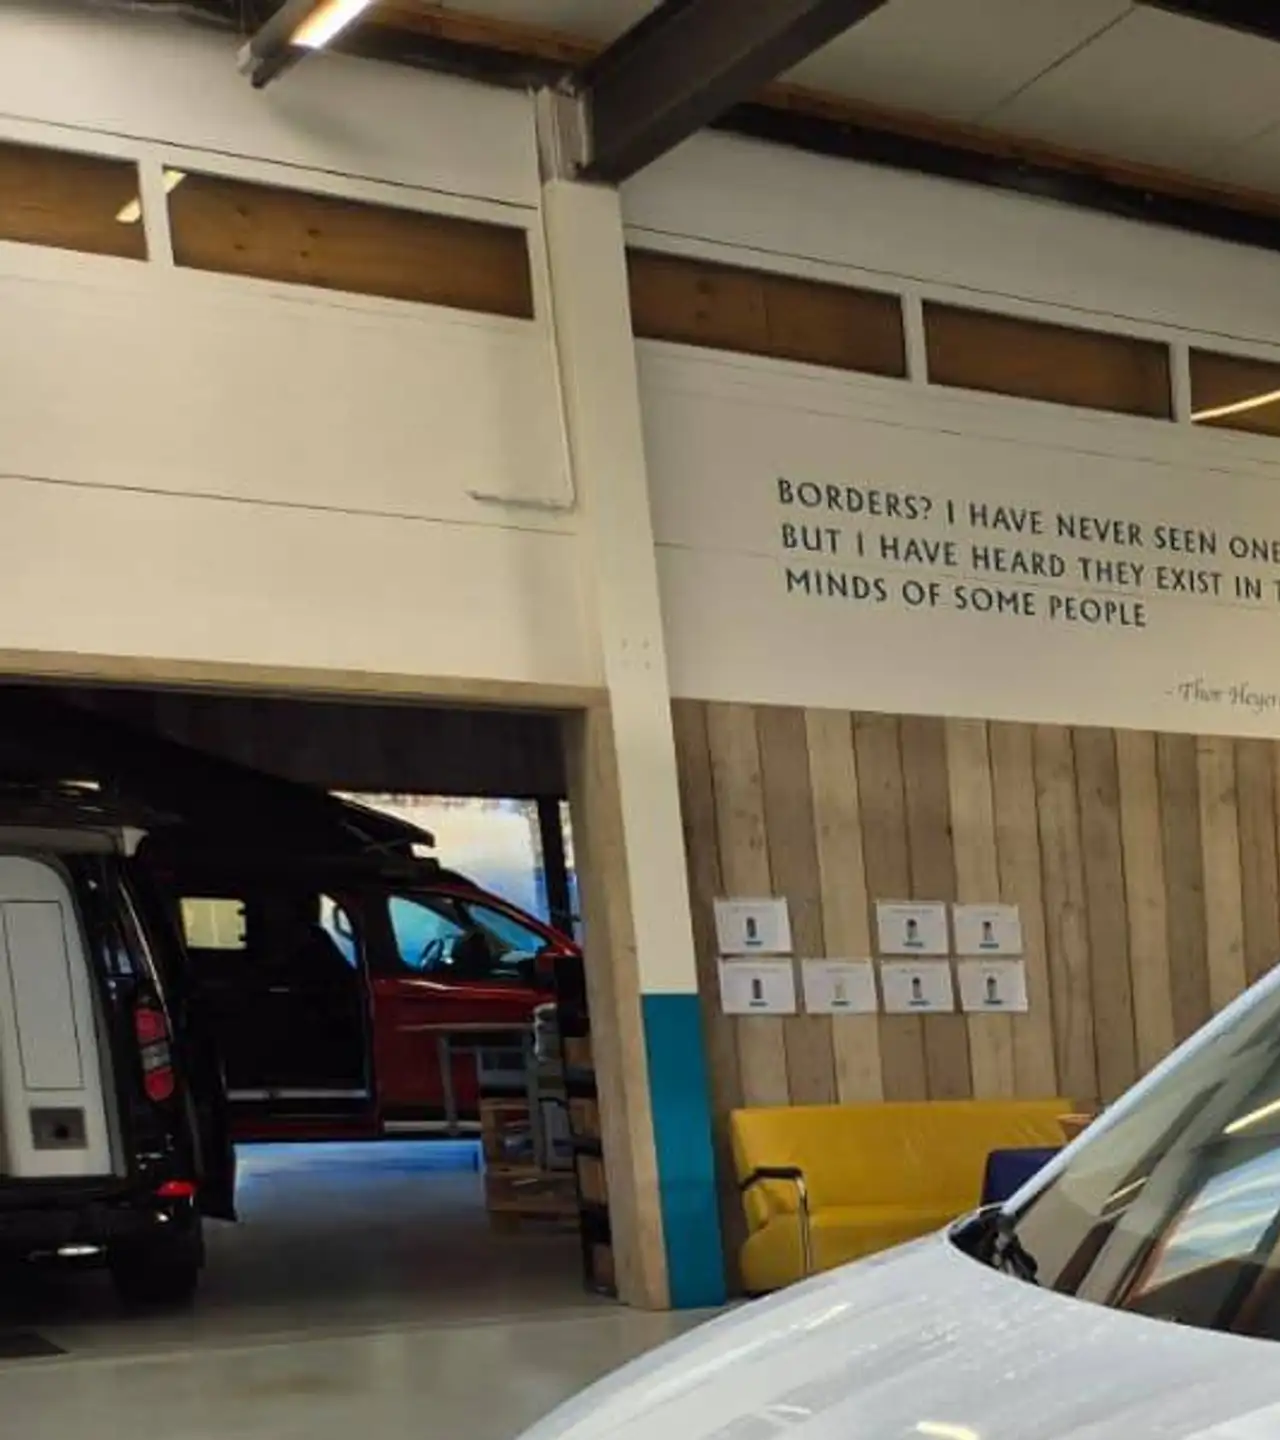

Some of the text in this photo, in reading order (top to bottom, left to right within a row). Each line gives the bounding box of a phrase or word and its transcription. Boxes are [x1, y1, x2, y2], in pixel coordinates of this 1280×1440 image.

[777, 476, 933, 521] BORDERS?
[947, 498, 955, 526] I
[969, 502, 1043, 536] HAVE
[1055, 512, 1145, 548] NEVER
[1153, 525, 1218, 555] SEEN
[781, 522, 842, 555] BUT
[857, 530, 864, 558] I
[880, 533, 958, 567] HAVE
[971, 545, 1066, 579] HEARD
[1077, 555, 1145, 588] THEY
[1156, 565, 1223, 597] EXIST
[1235, 575, 1263, 601] IN
[785, 567, 1147, 629] MINDS OF SOME PEOPLE
